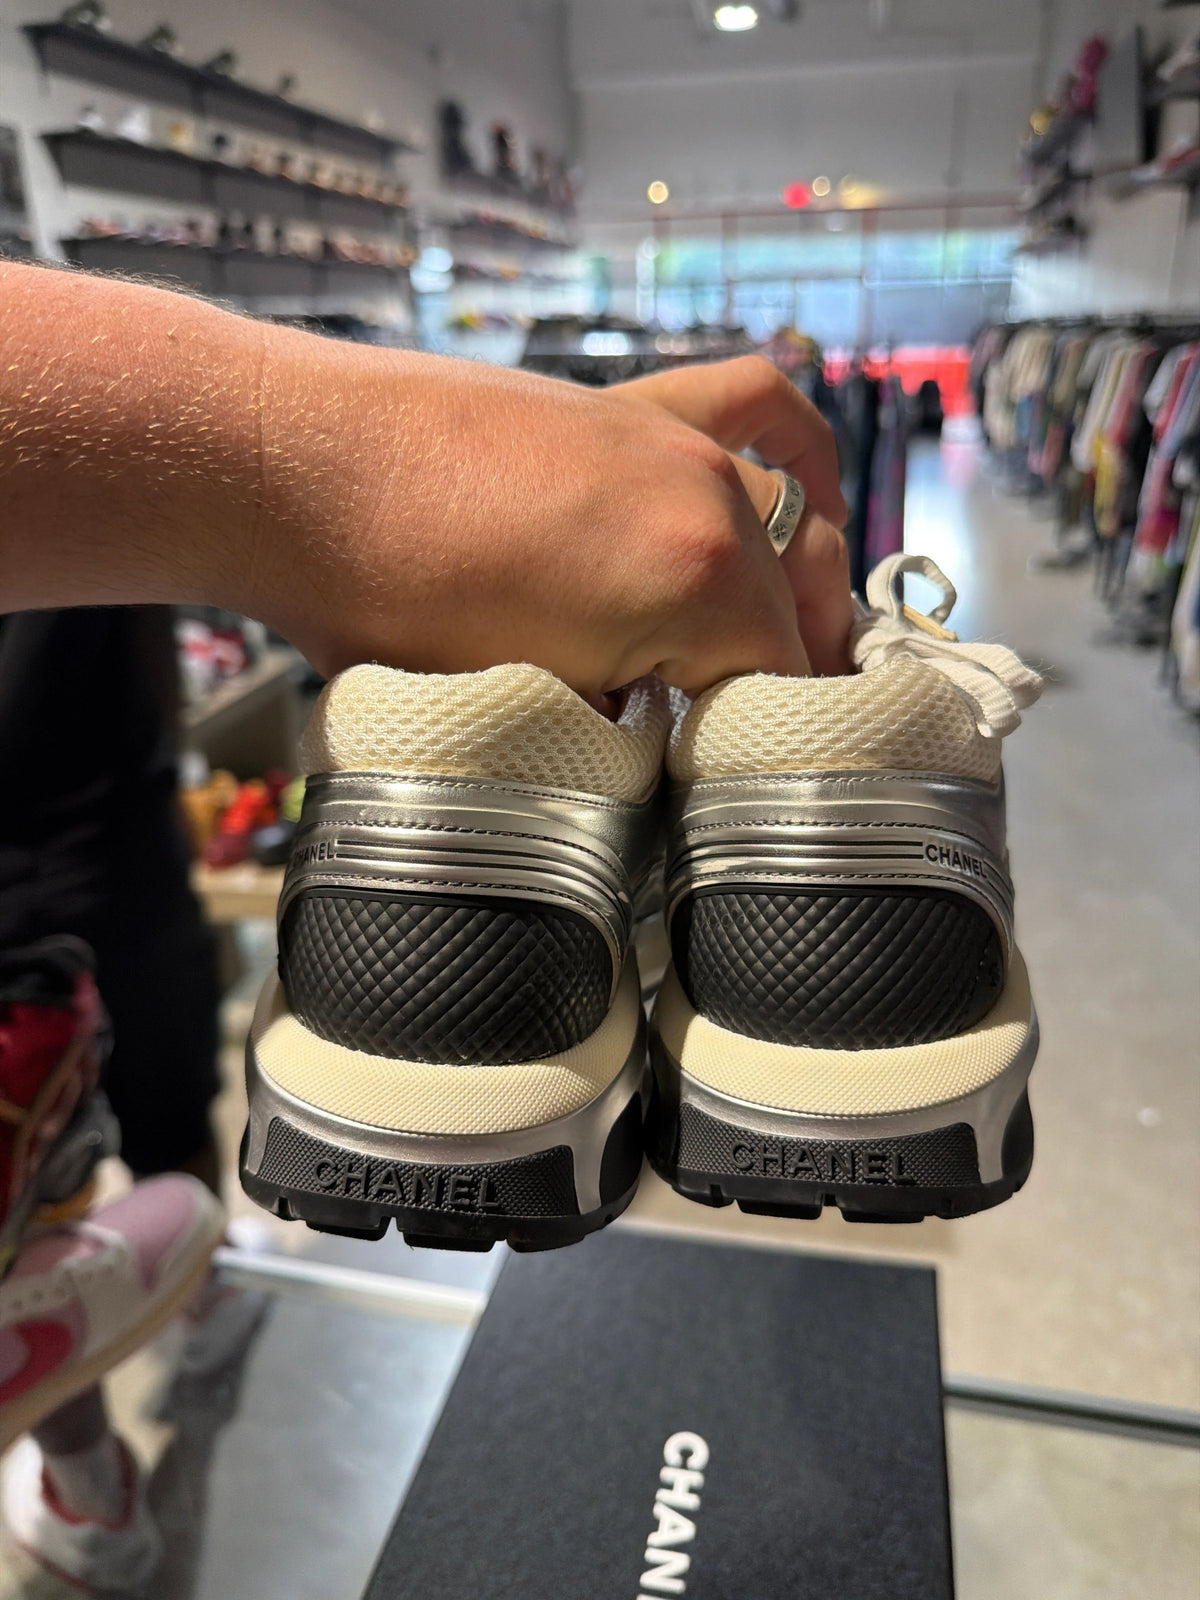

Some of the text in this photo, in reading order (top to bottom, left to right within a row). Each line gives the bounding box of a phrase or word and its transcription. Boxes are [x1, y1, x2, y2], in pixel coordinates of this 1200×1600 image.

[293, 840, 335, 866] HANEL
[925, 844, 988, 879] CHANEL
[313, 1158, 500, 1207] CHANEL
[732, 1140, 914, 1183] CHANEL
[636, 1431, 710, 1600] CHAN
